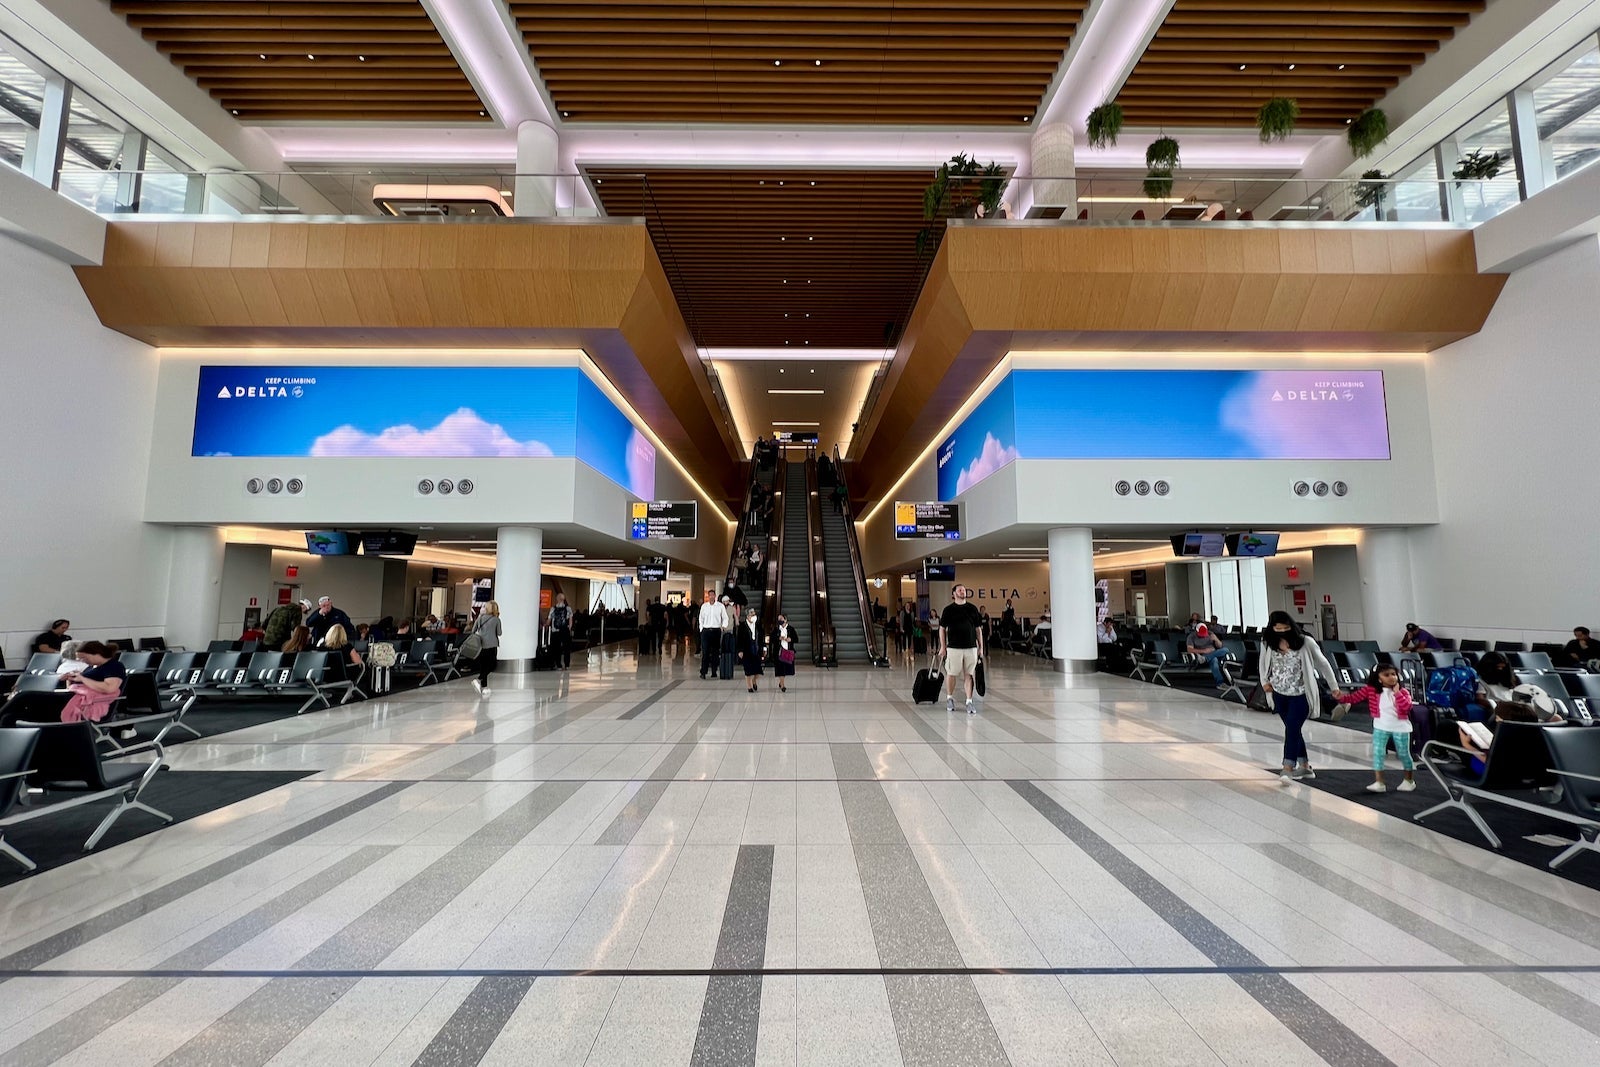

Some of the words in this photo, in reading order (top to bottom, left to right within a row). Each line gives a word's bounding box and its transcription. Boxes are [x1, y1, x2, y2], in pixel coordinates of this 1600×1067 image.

[236, 386, 288, 398] DELTA
[1287, 390, 1339, 401] DELTA
[930, 556, 939, 564] 71
[965, 588, 1020, 599] DELTA
